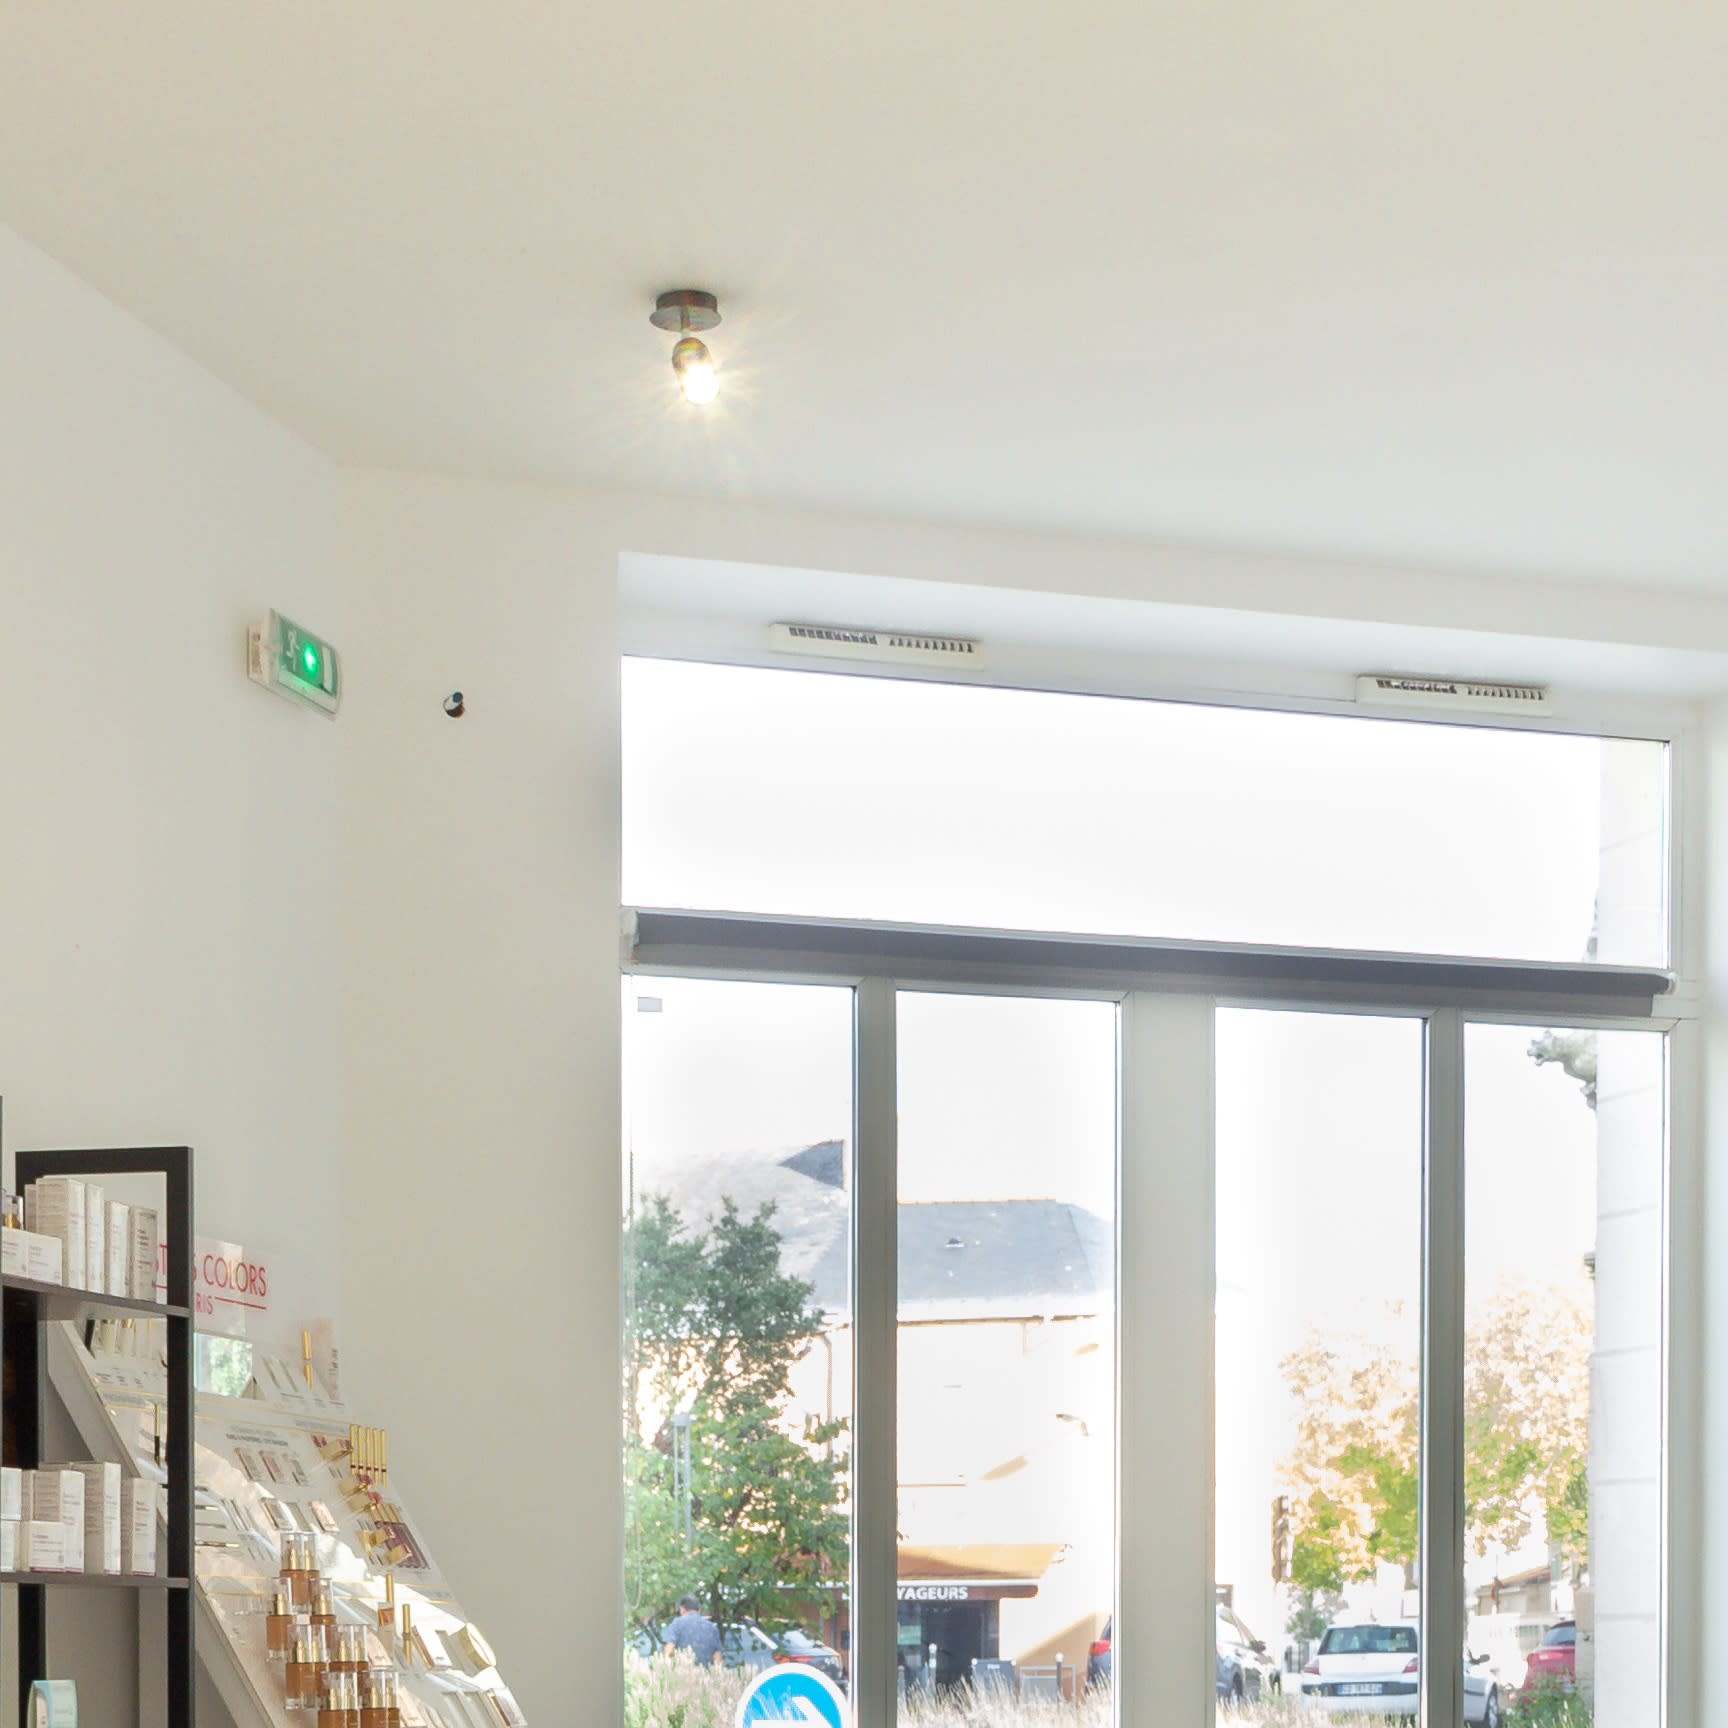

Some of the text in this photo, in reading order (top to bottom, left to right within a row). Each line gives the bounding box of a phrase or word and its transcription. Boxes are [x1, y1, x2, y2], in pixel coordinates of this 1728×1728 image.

[203, 1254, 267, 1297] COLORS
[195, 1292, 214, 1315] RIS
[896, 1586, 969, 1600] YAGEURS
